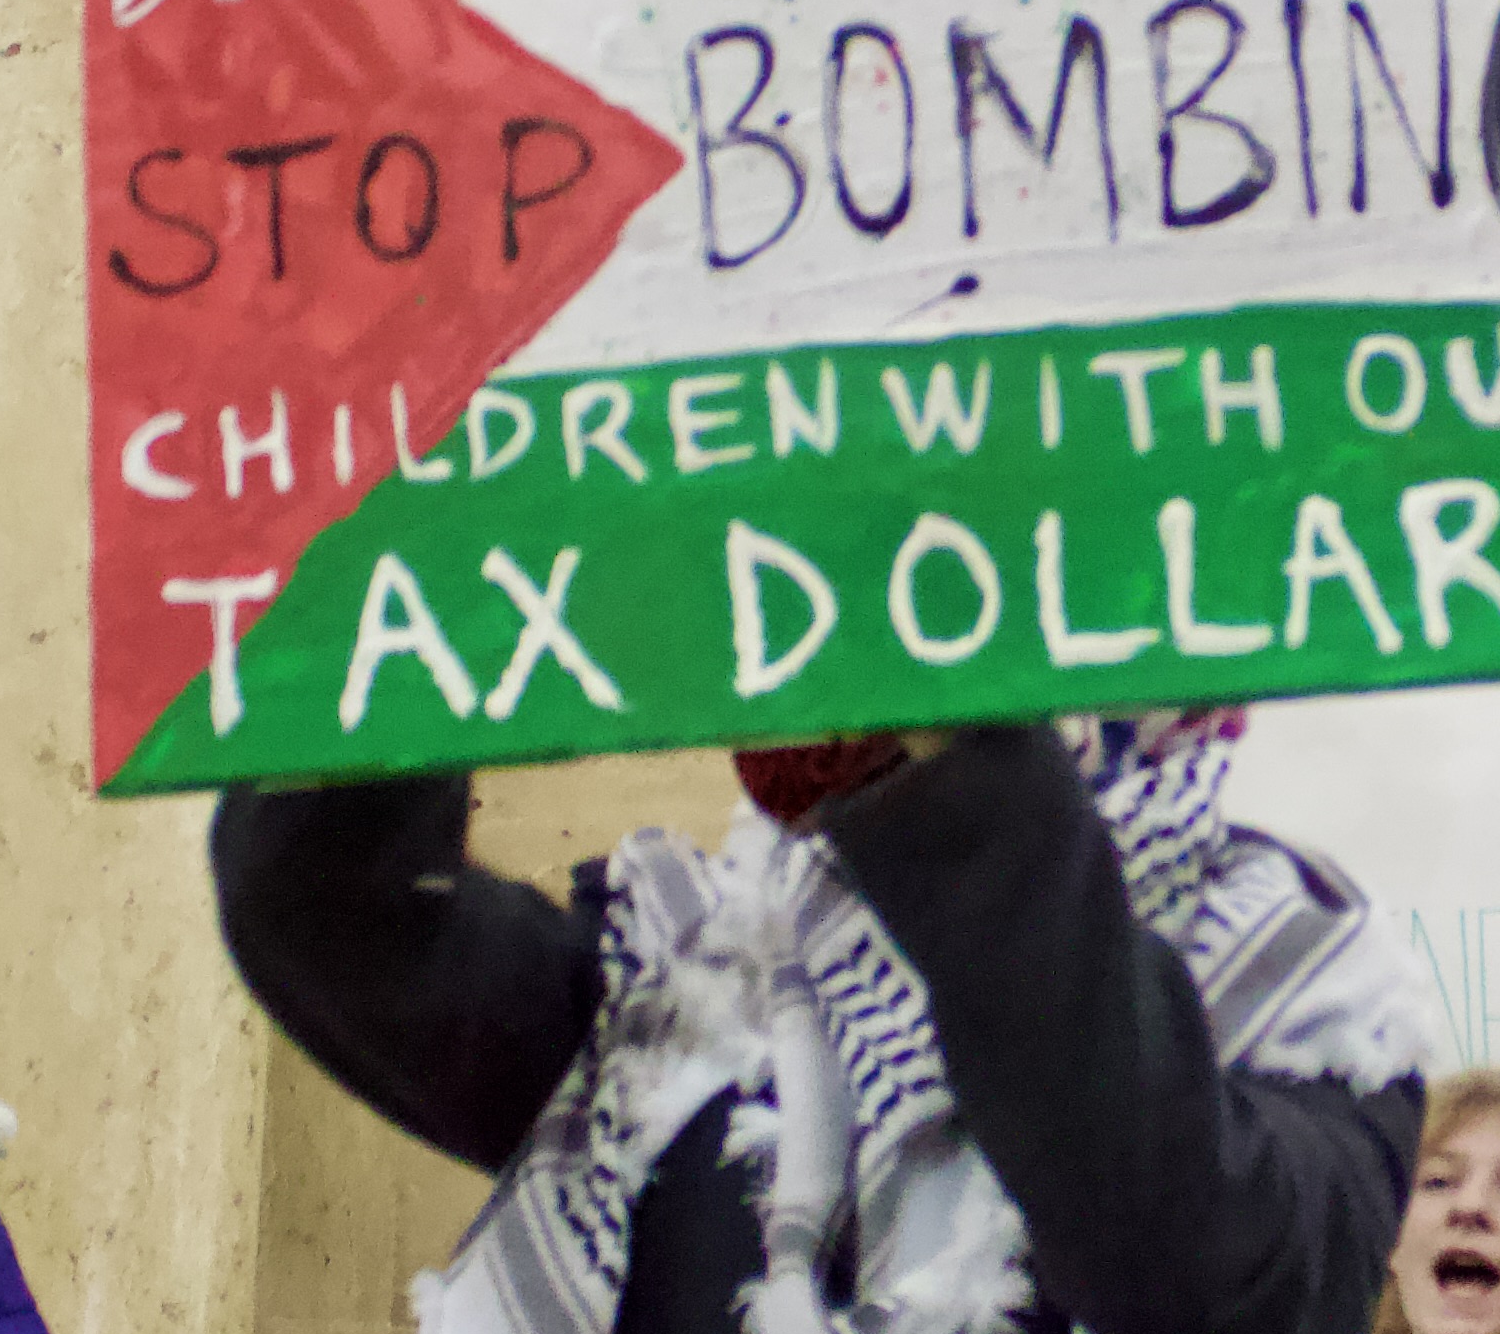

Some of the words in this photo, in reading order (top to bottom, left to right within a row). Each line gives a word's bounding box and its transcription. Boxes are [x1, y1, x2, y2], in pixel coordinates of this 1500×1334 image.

[108, 117, 595, 296] STOP
[121, 358, 841, 501] CHILDREN
[882, 345, 1284, 455] WITH
[161, 546, 626, 737] TAX
